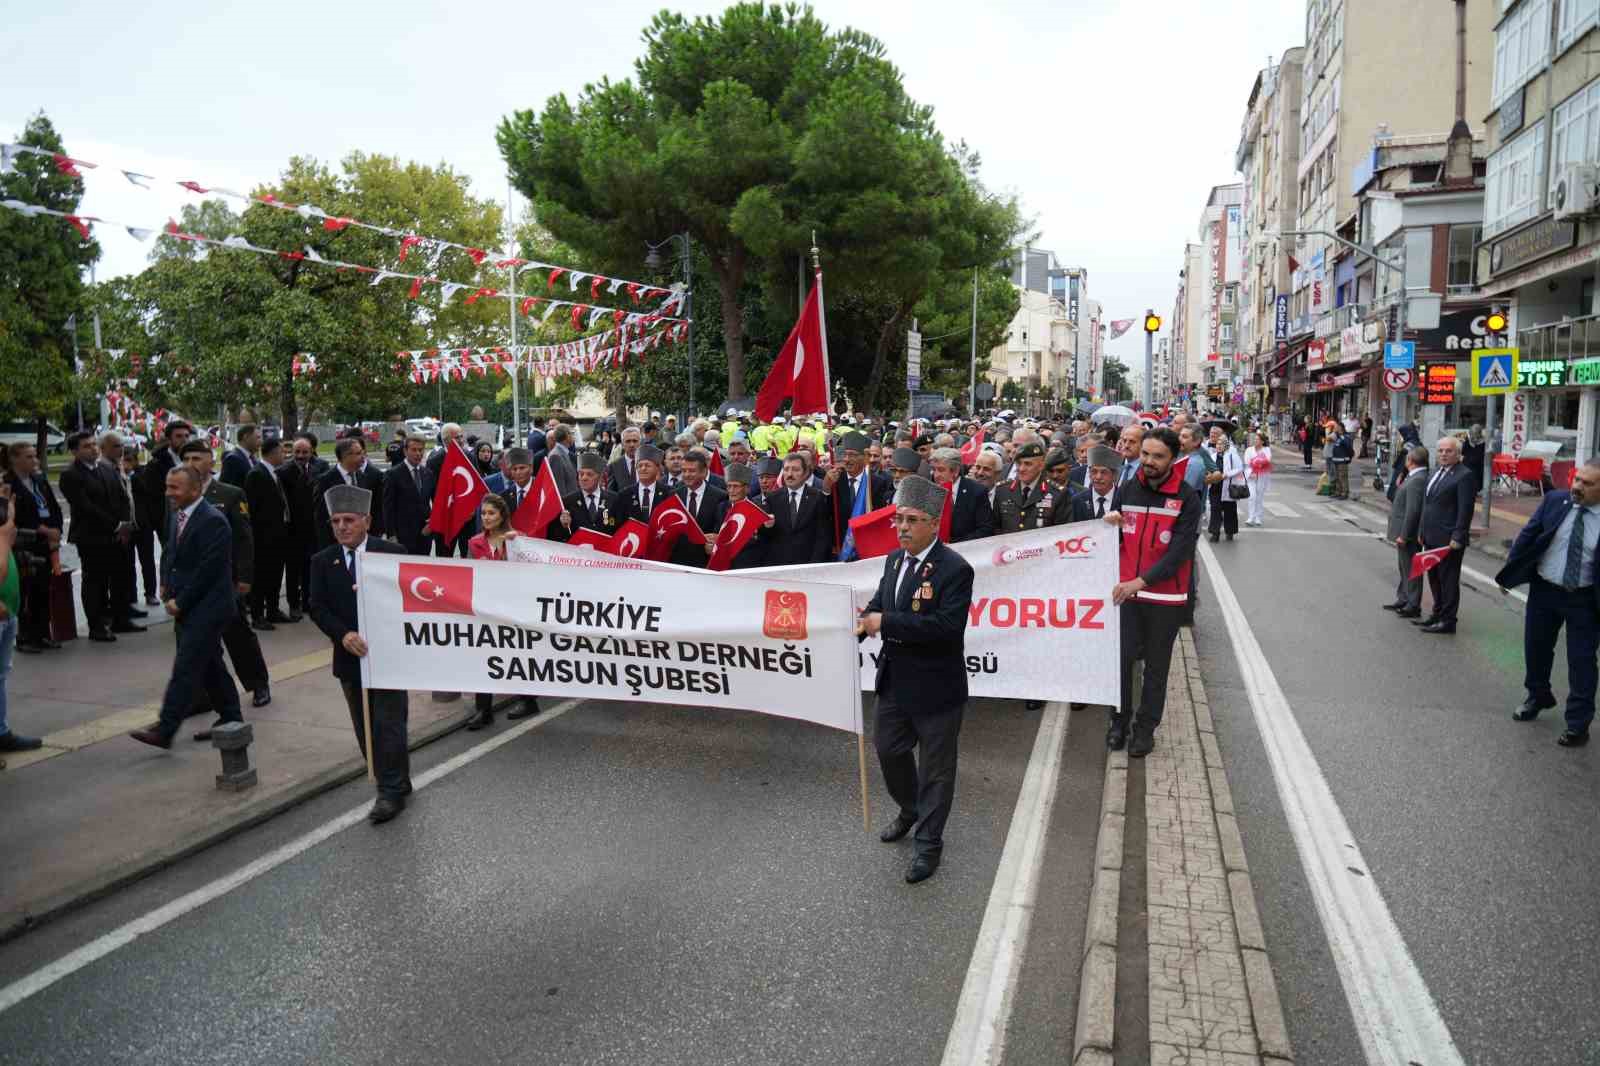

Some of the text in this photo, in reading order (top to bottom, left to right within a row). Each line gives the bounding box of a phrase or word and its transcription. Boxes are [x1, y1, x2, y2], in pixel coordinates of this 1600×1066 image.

[536, 591, 662, 633] TÜRKİYE
[404, 622, 813, 678] MUHARİP GAZİLER DERNEĞİ
[487, 656, 731, 696] SAMSUN ŞUBESİ
